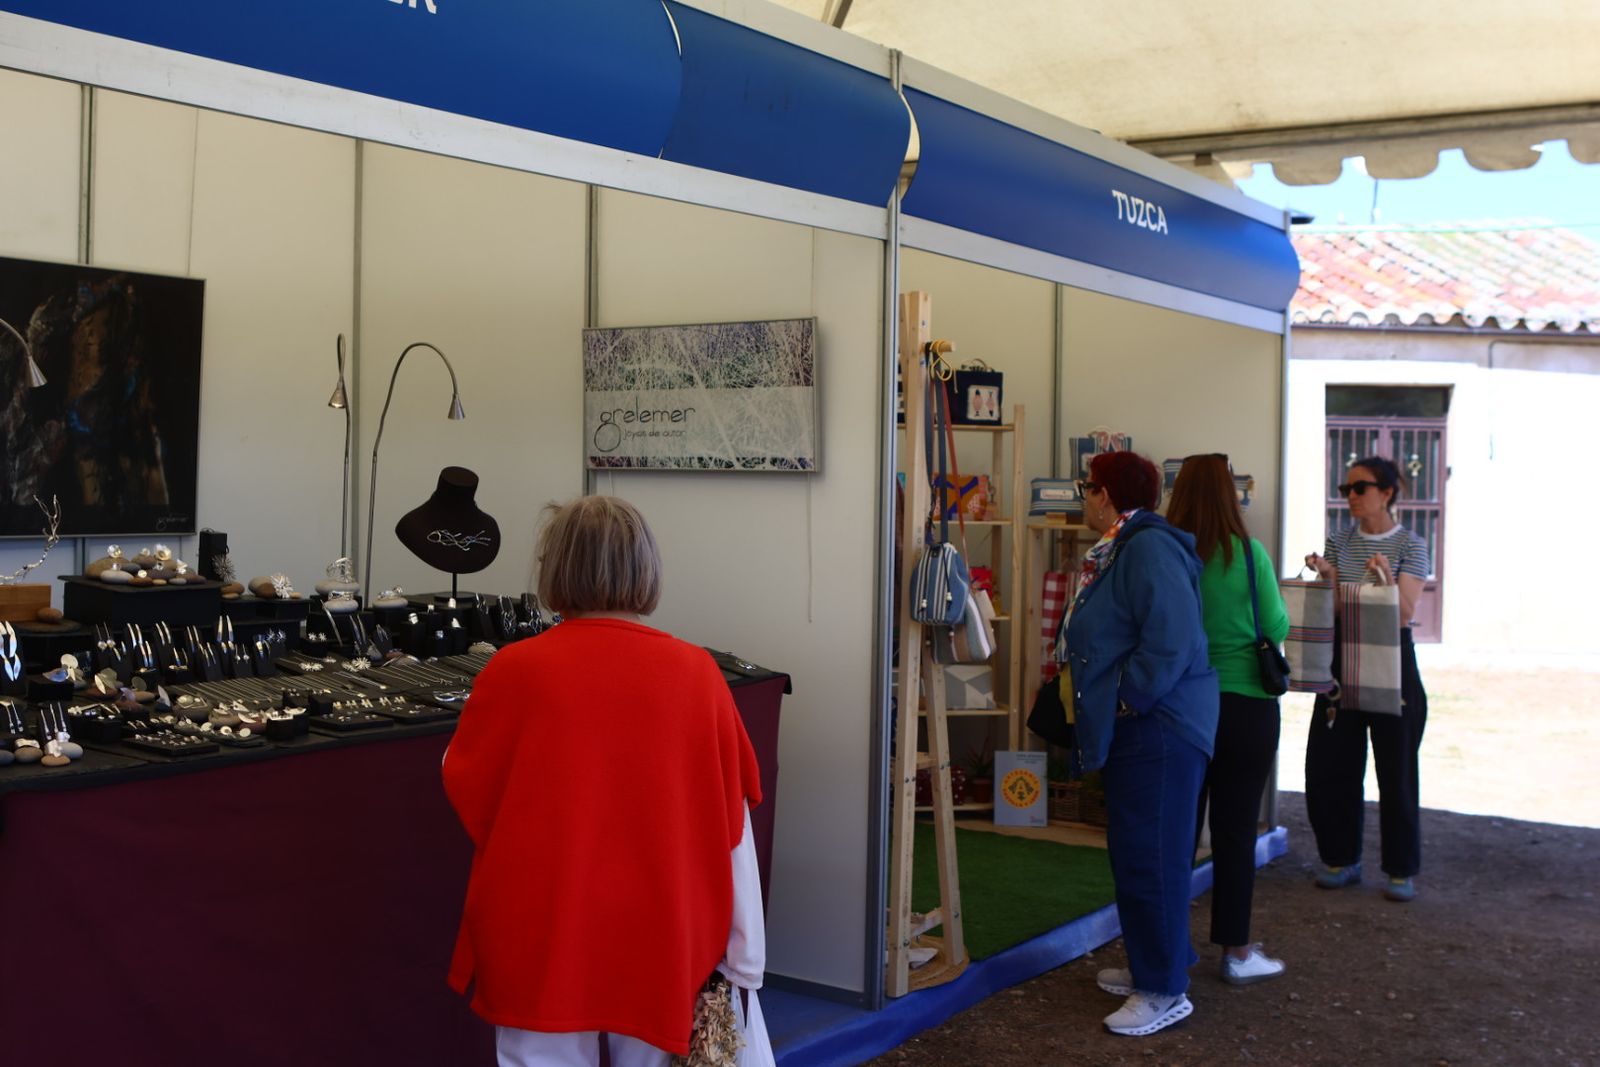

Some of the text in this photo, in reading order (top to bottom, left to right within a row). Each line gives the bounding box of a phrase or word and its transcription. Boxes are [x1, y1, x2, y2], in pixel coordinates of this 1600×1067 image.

[1111, 189, 1168, 235] TUZCA
[594, 395, 696, 453] grelemer
[623, 428, 647, 441] joyas
[648, 427, 660, 438] de
